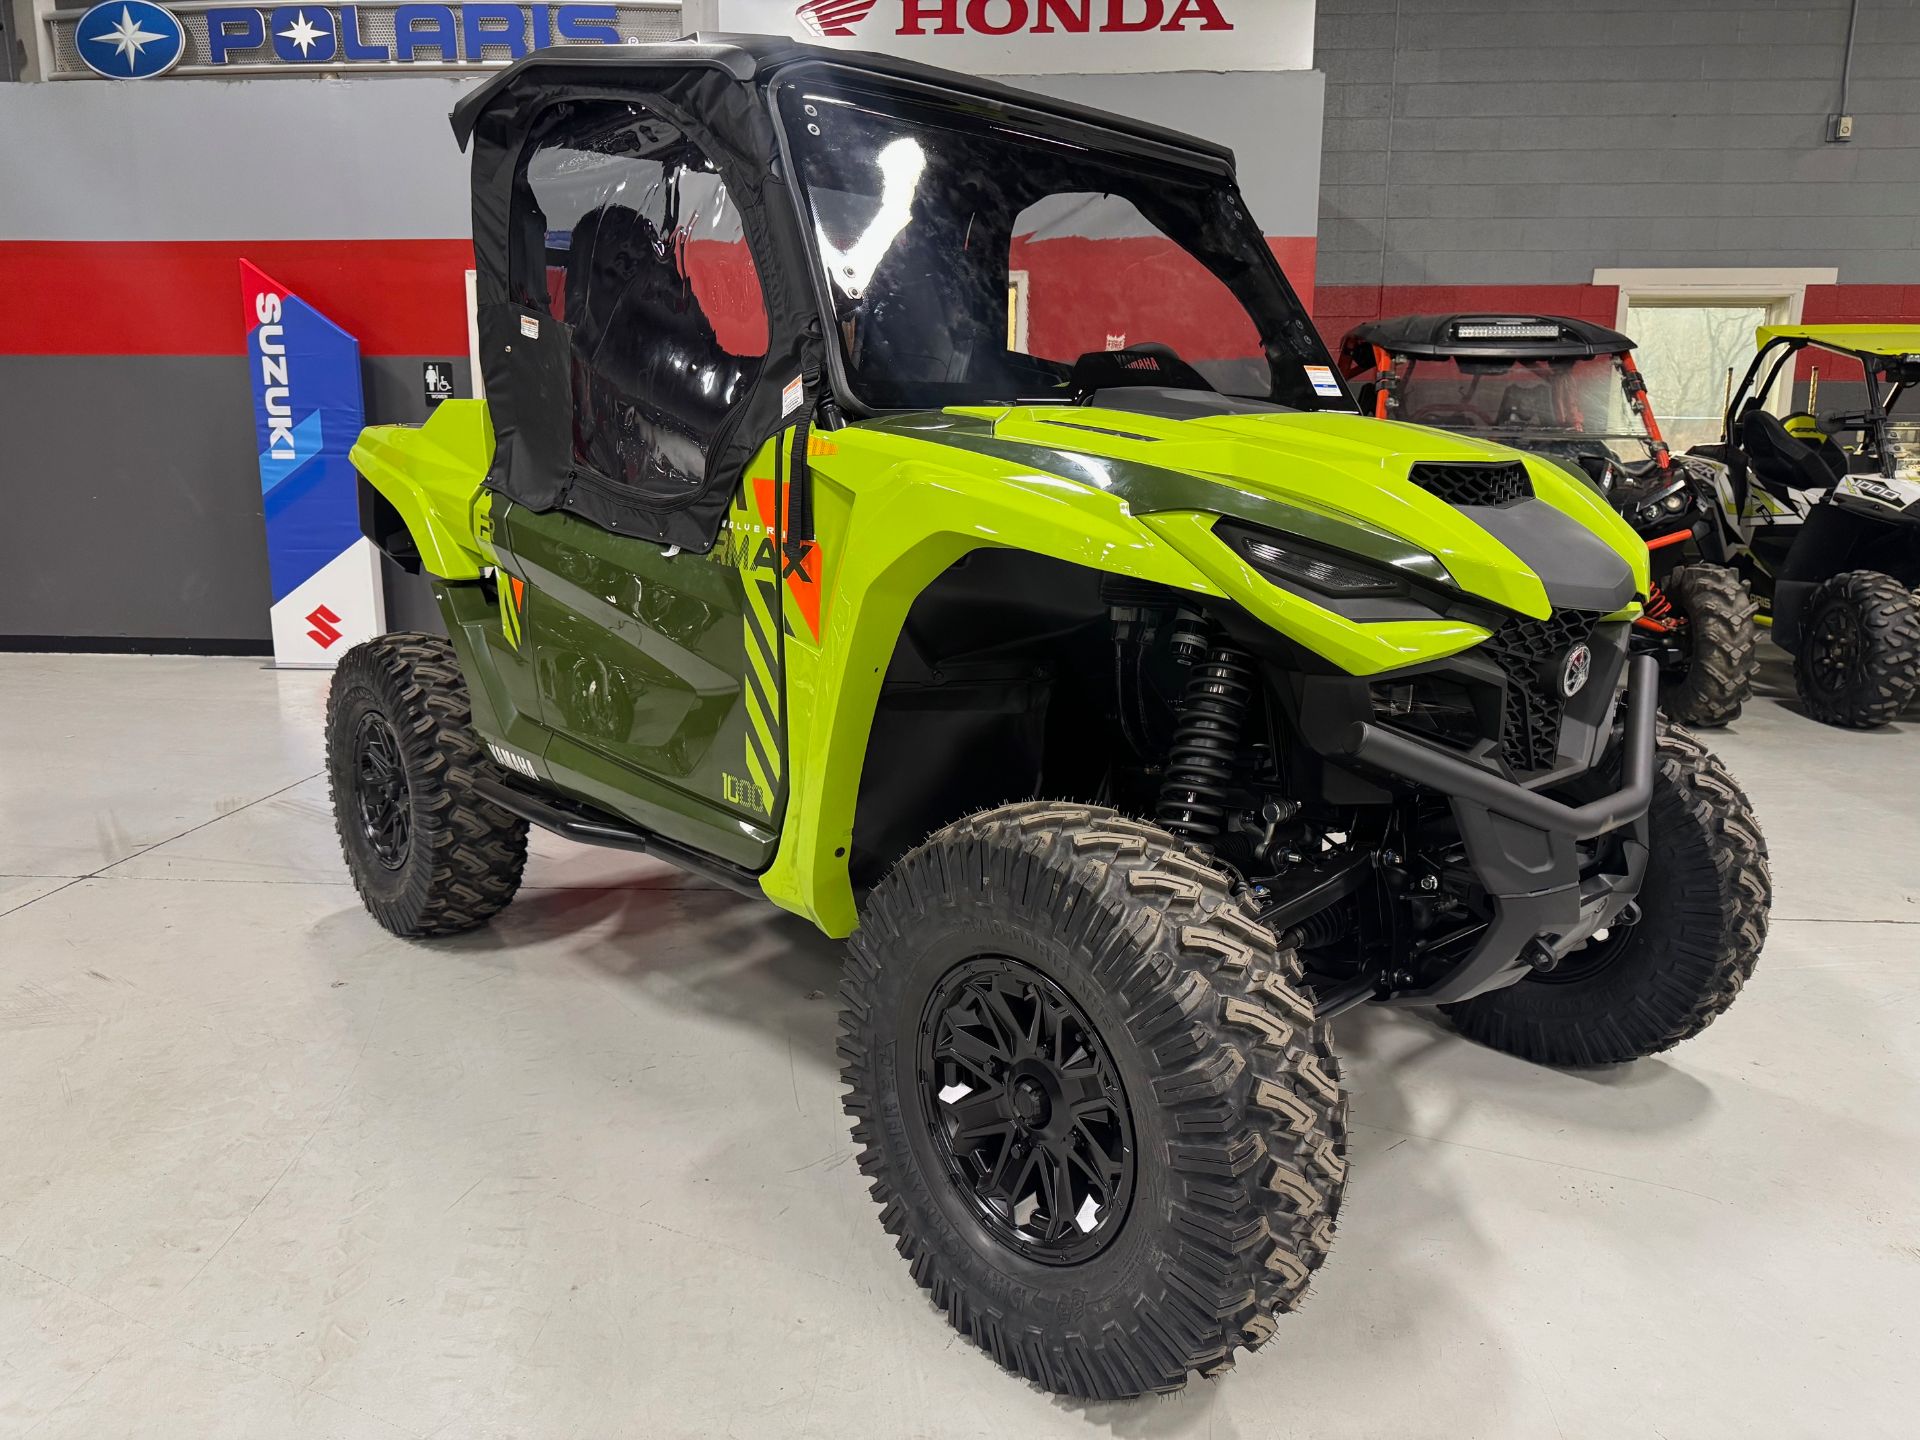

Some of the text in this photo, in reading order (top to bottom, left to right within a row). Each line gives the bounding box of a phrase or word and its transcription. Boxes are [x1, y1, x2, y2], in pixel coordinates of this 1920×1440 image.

[210, 4, 620, 63] POLARIS
[895, 0, 1235, 35] HONDA
[256, 292, 296, 460] SUZUKI
[1750, 593, 1771, 609] ARIS
[486, 743, 541, 782] YAMAHA
[722, 772, 764, 813] 1000
